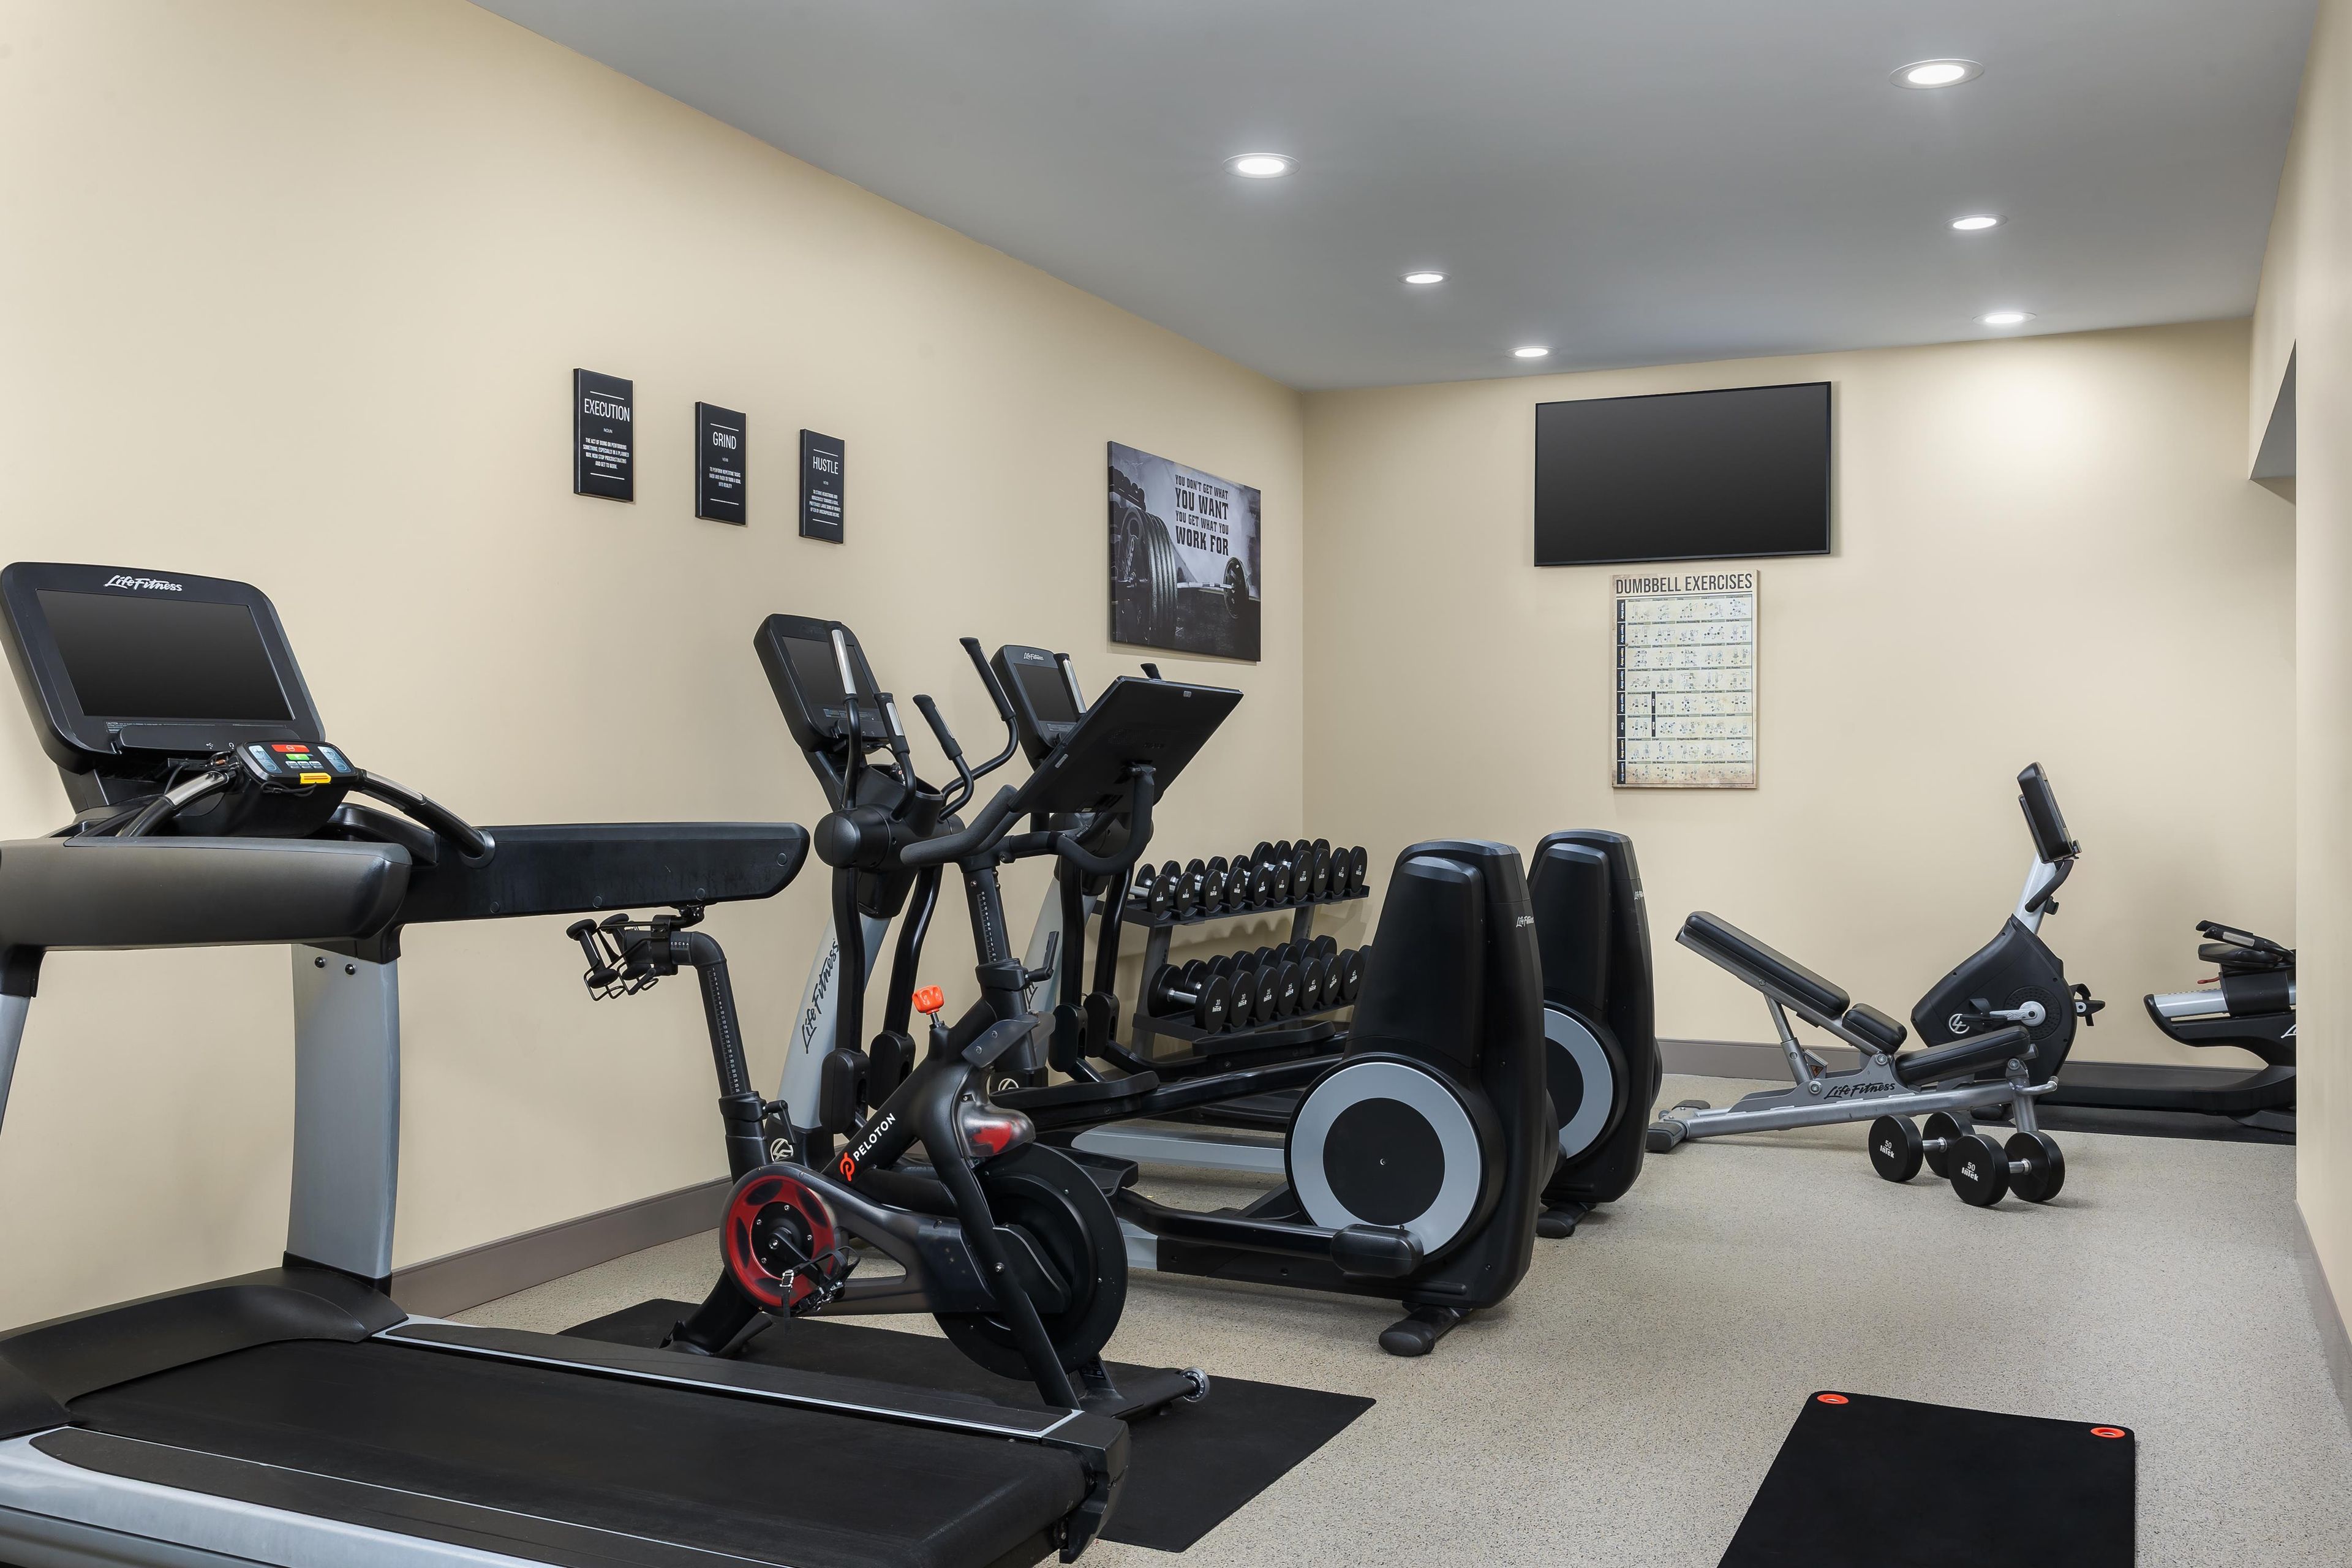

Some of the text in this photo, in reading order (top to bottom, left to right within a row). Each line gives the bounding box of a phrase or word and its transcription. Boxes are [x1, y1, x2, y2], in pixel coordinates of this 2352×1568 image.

[584, 398, 630, 422] EXECUTION
[713, 431, 736, 450] GRIND
[813, 456, 839, 475] HUSTLE
[1175, 474, 1229, 500] YOU DON'T GET WHAT
[1175, 487, 1229, 520] YOU WANT
[1175, 510, 1229, 535] YOU GET WHAT YOU
[1175, 525, 1229, 556] WORK FOR
[1616, 573, 1752, 594] DUMBBELL EXERCISES
[853, 1112, 896, 1161] PELOTON
[1885, 1140, 1892, 1149] 50
[1879, 1145, 1894, 1159] InTek
[1961, 1167, 1979, 1182] InTek
[1967, 1161, 1976, 1172] 50
